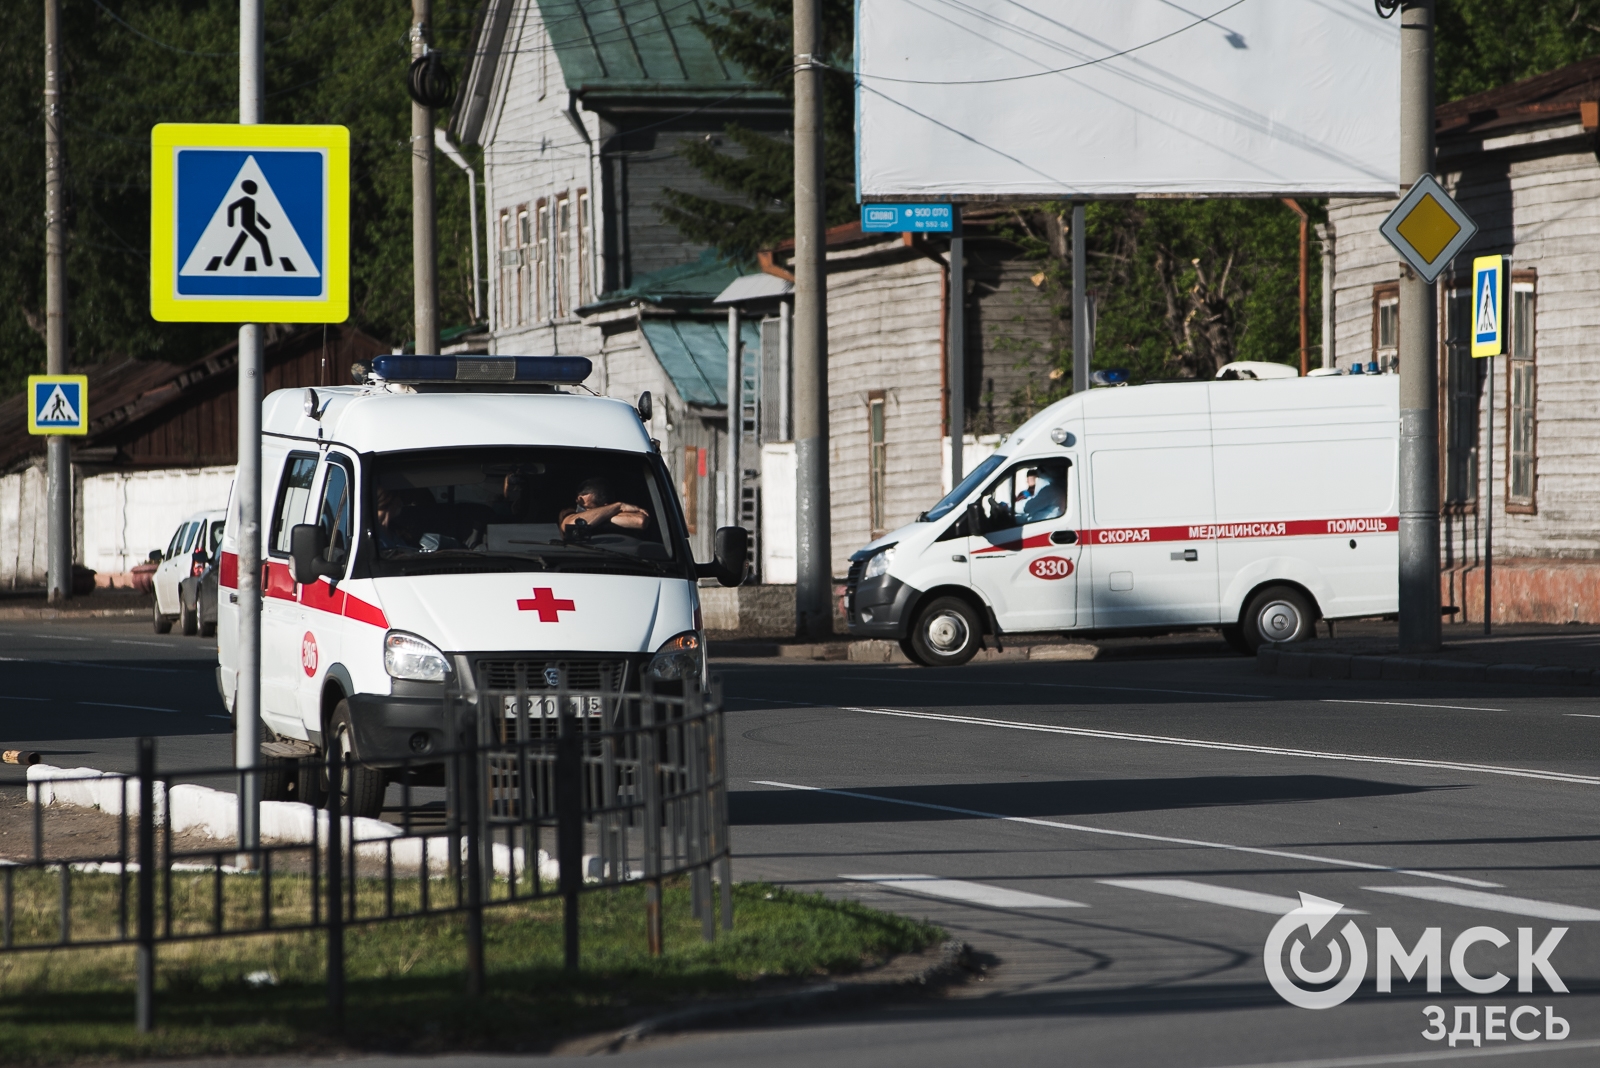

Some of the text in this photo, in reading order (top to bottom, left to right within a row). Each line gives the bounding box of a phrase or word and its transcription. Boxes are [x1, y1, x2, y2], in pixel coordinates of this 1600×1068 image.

[1098, 519, 1388, 543] СКОРАЯ МЕДИЦИНСКАЯ ПОМОЩЬ
[1035, 560, 1068, 576] 330
